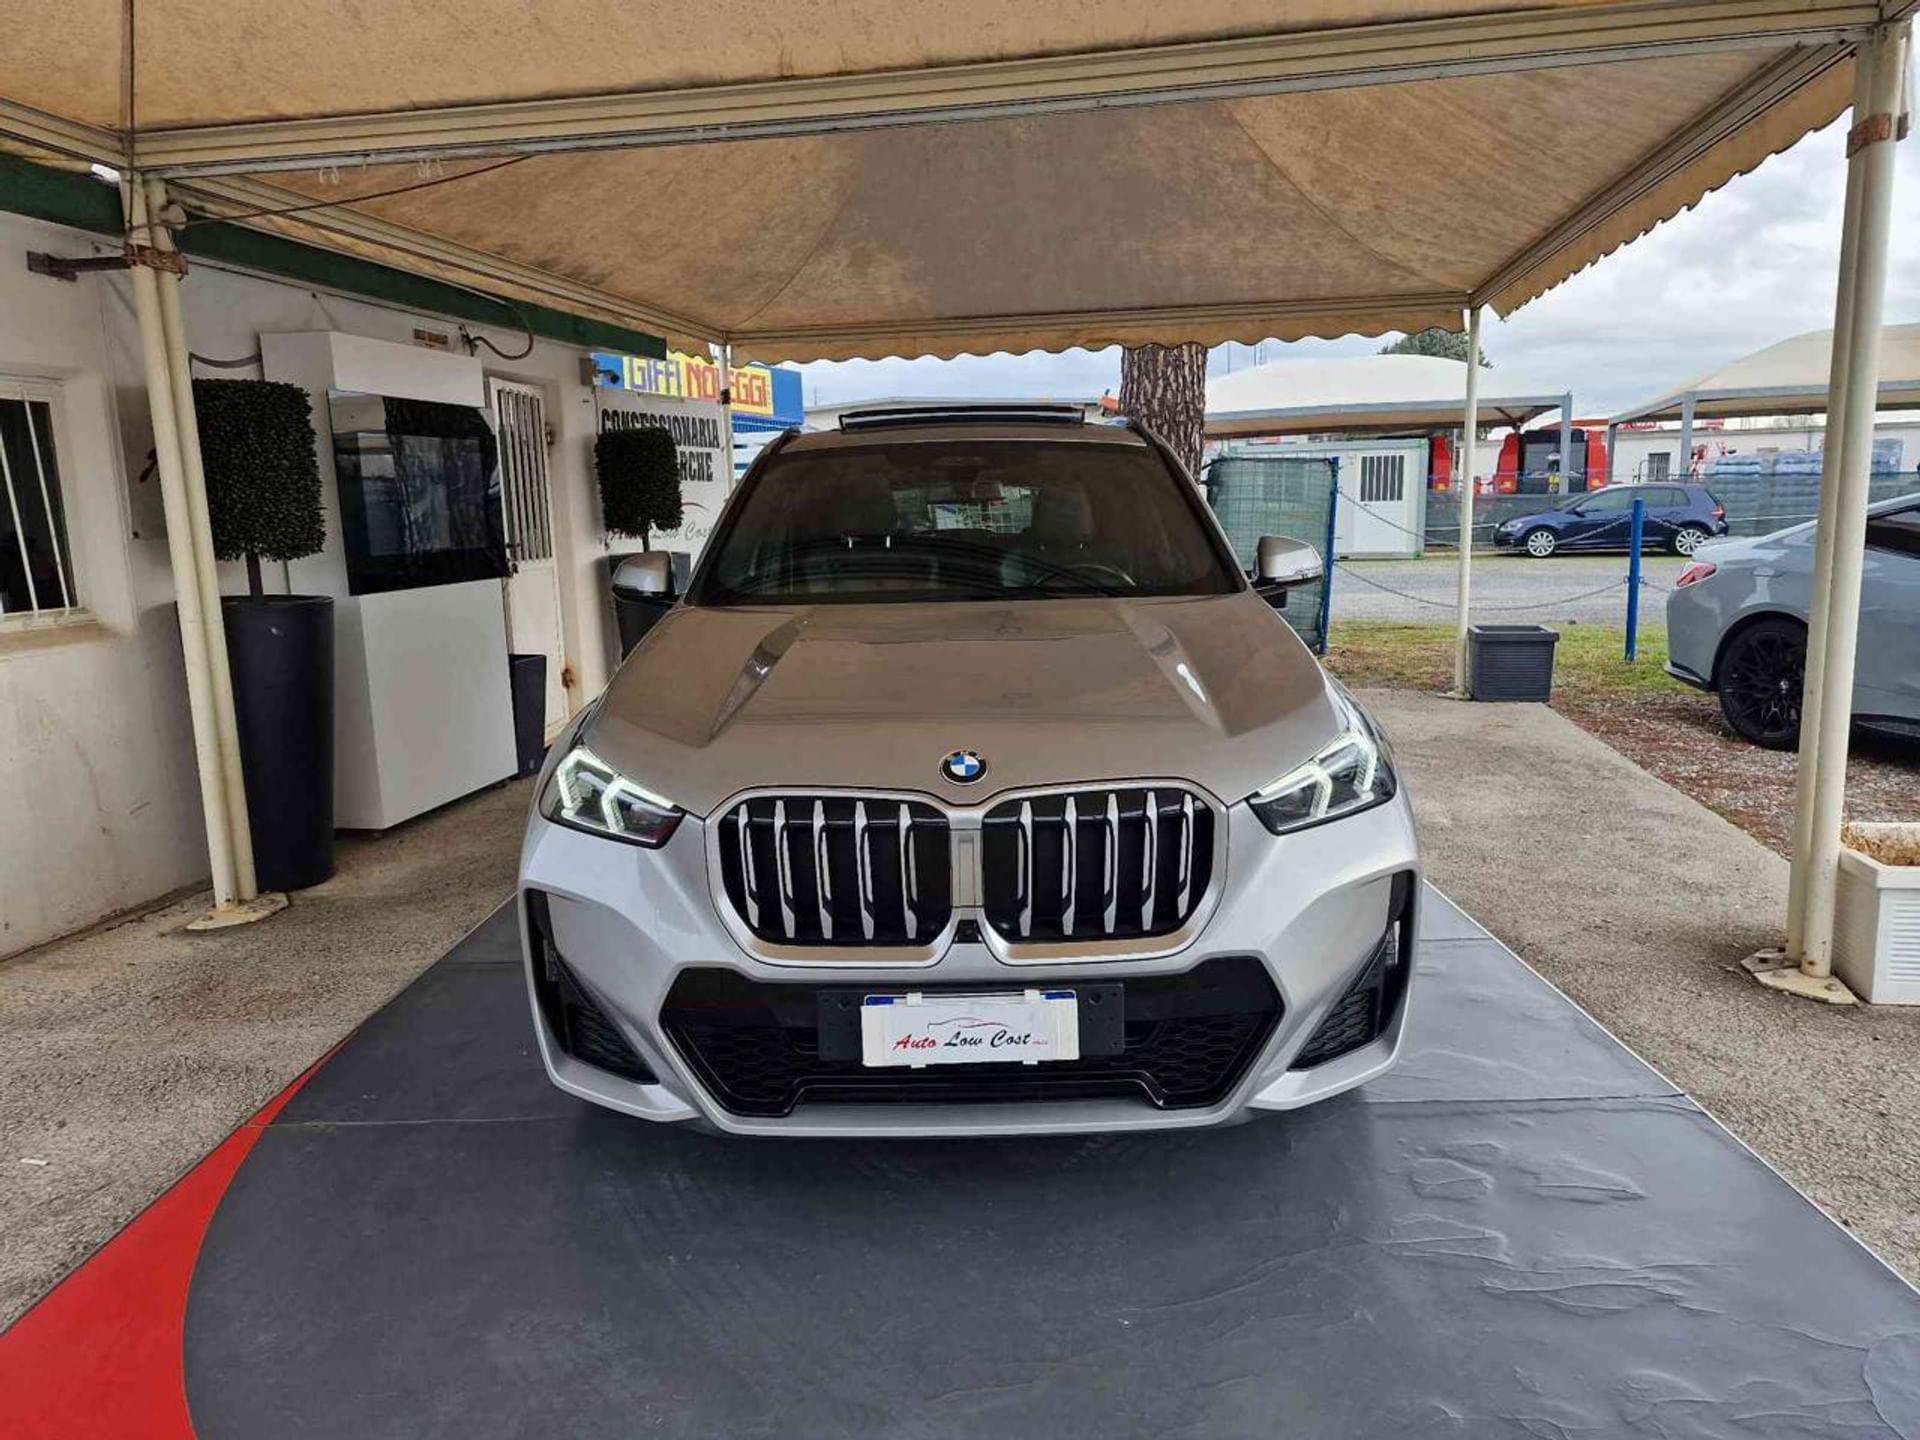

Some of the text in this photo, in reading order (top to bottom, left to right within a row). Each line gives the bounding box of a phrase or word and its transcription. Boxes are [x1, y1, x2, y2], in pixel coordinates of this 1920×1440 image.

[892, 1034, 937, 1050] Auto
[944, 1031, 982, 1047] Low
[990, 1029, 1031, 1048] Cost
